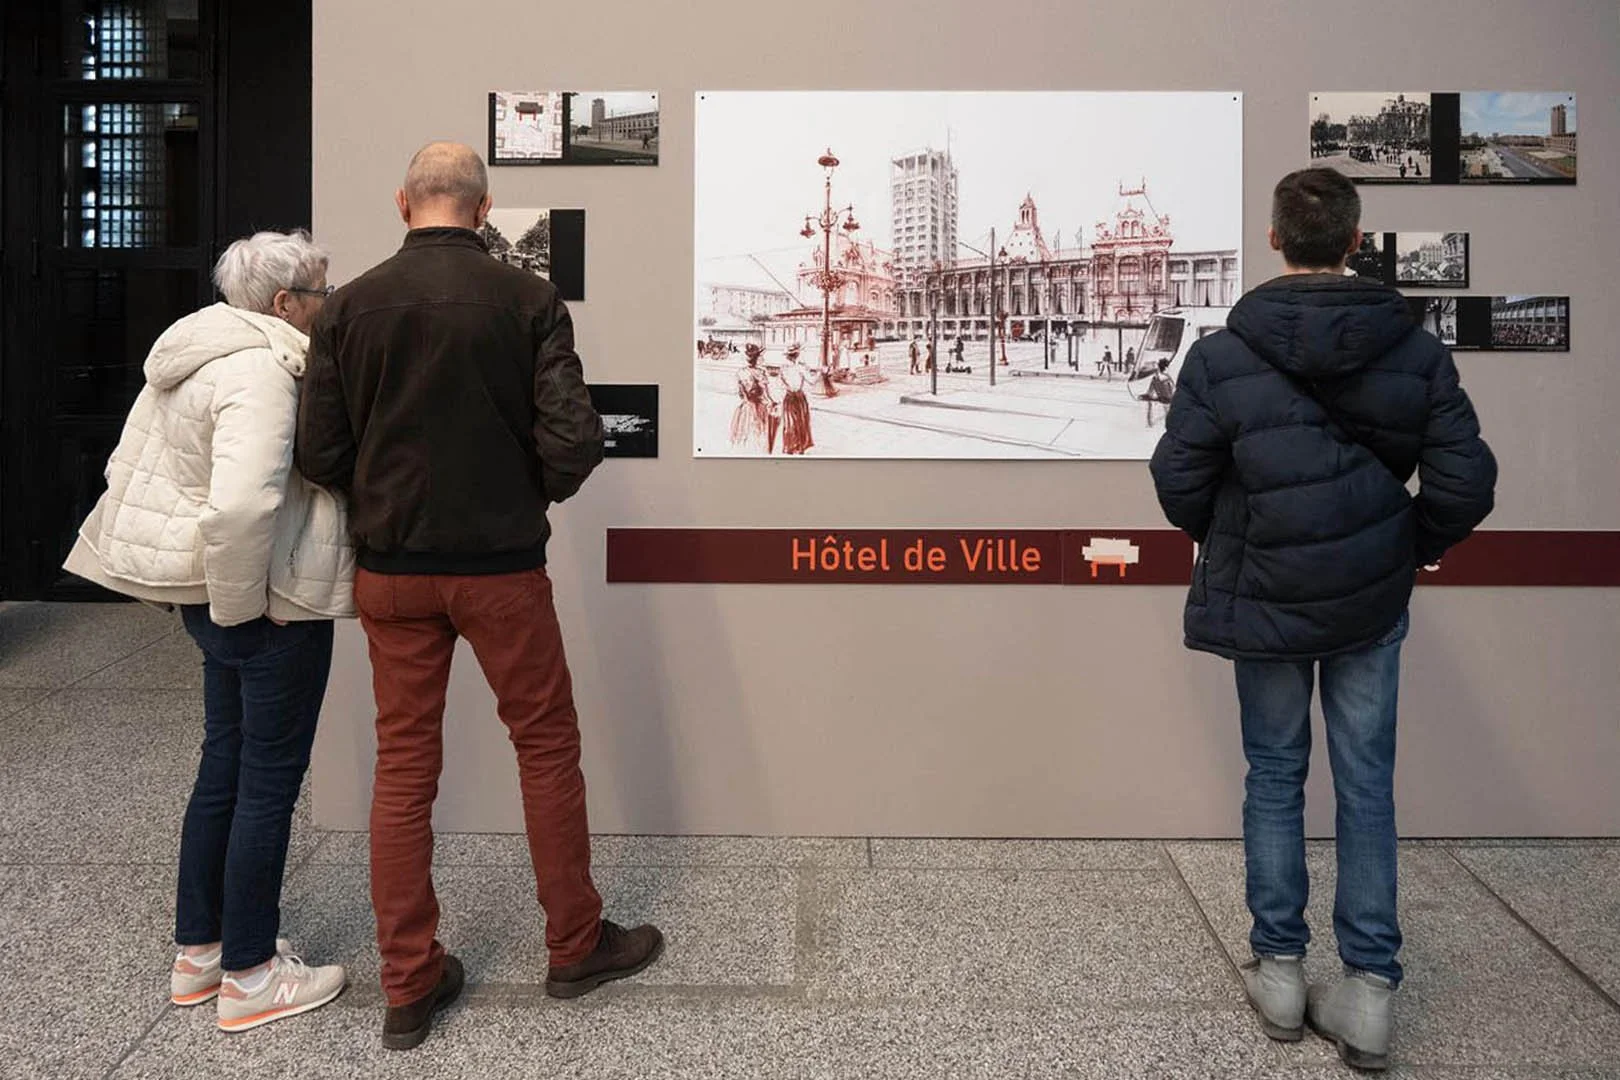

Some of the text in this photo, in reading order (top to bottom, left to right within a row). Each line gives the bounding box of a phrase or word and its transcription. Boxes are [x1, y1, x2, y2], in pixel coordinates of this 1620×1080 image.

[791, 535, 1041, 571] Hôtel de Ville
[273, 982, 300, 1004] N
